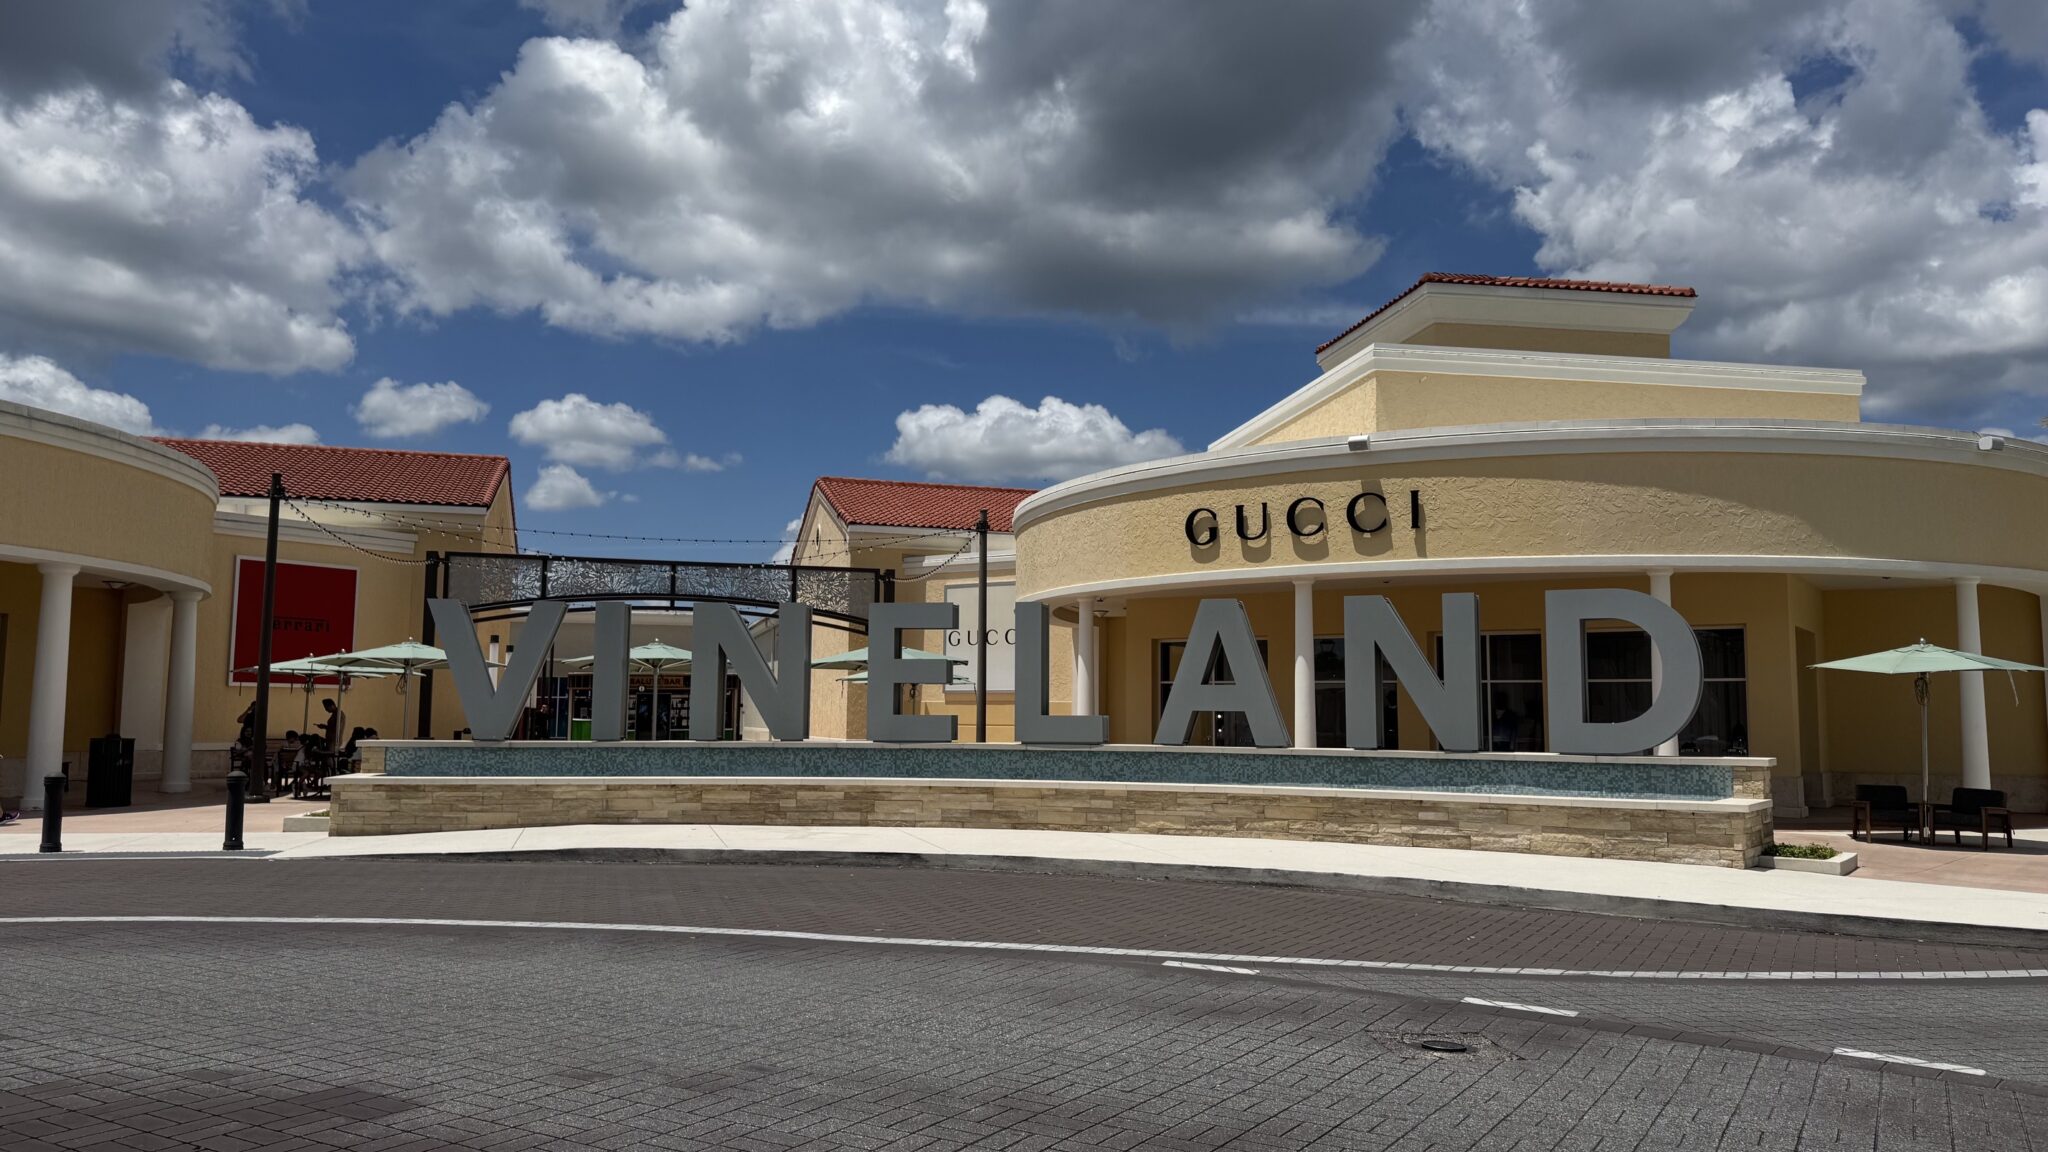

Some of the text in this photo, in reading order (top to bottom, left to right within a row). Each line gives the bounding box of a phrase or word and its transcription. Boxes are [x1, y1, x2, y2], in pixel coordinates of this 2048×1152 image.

[1185, 490, 1421, 546] GUCCI
[273, 616, 330, 632] errari
[948, 628, 1016, 646] GUCC
[428, 588, 1704, 754] VINELAND
[664, 677, 681, 685] BAR
